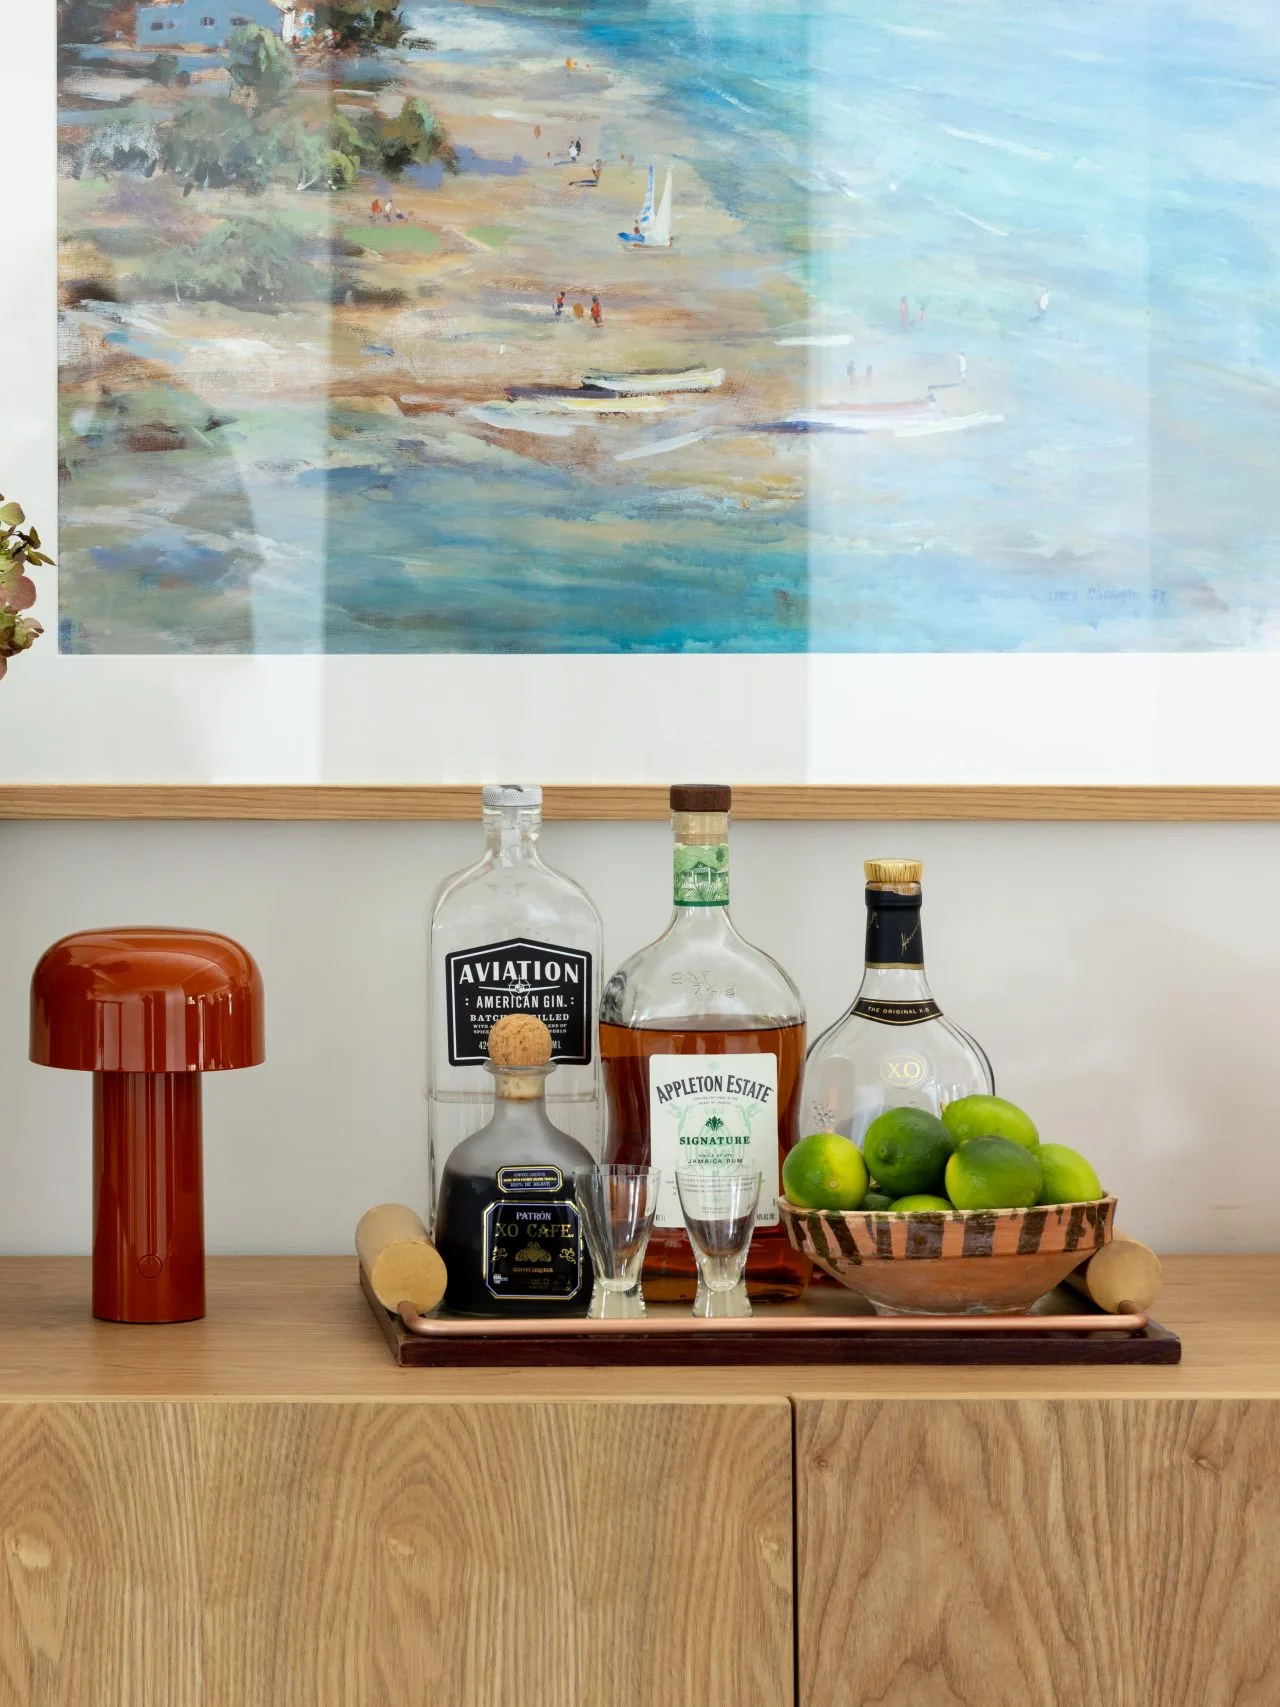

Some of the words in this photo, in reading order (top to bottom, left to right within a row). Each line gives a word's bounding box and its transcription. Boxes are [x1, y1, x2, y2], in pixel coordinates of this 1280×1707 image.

[459, 960, 579, 985] AVIATION
[476, 995, 539, 1009] AMERICAN
[543, 994, 564, 1008] GIN
[531, 1013, 570, 1021] ILLED
[655, 1075, 723, 1104] APPLETON
[726, 1074, 773, 1104] ESTATE
[679, 1136, 751, 1145] SIGNATURE
[515, 1210, 552, 1221] PATRÓN
[494, 1223, 519, 1238] XO
